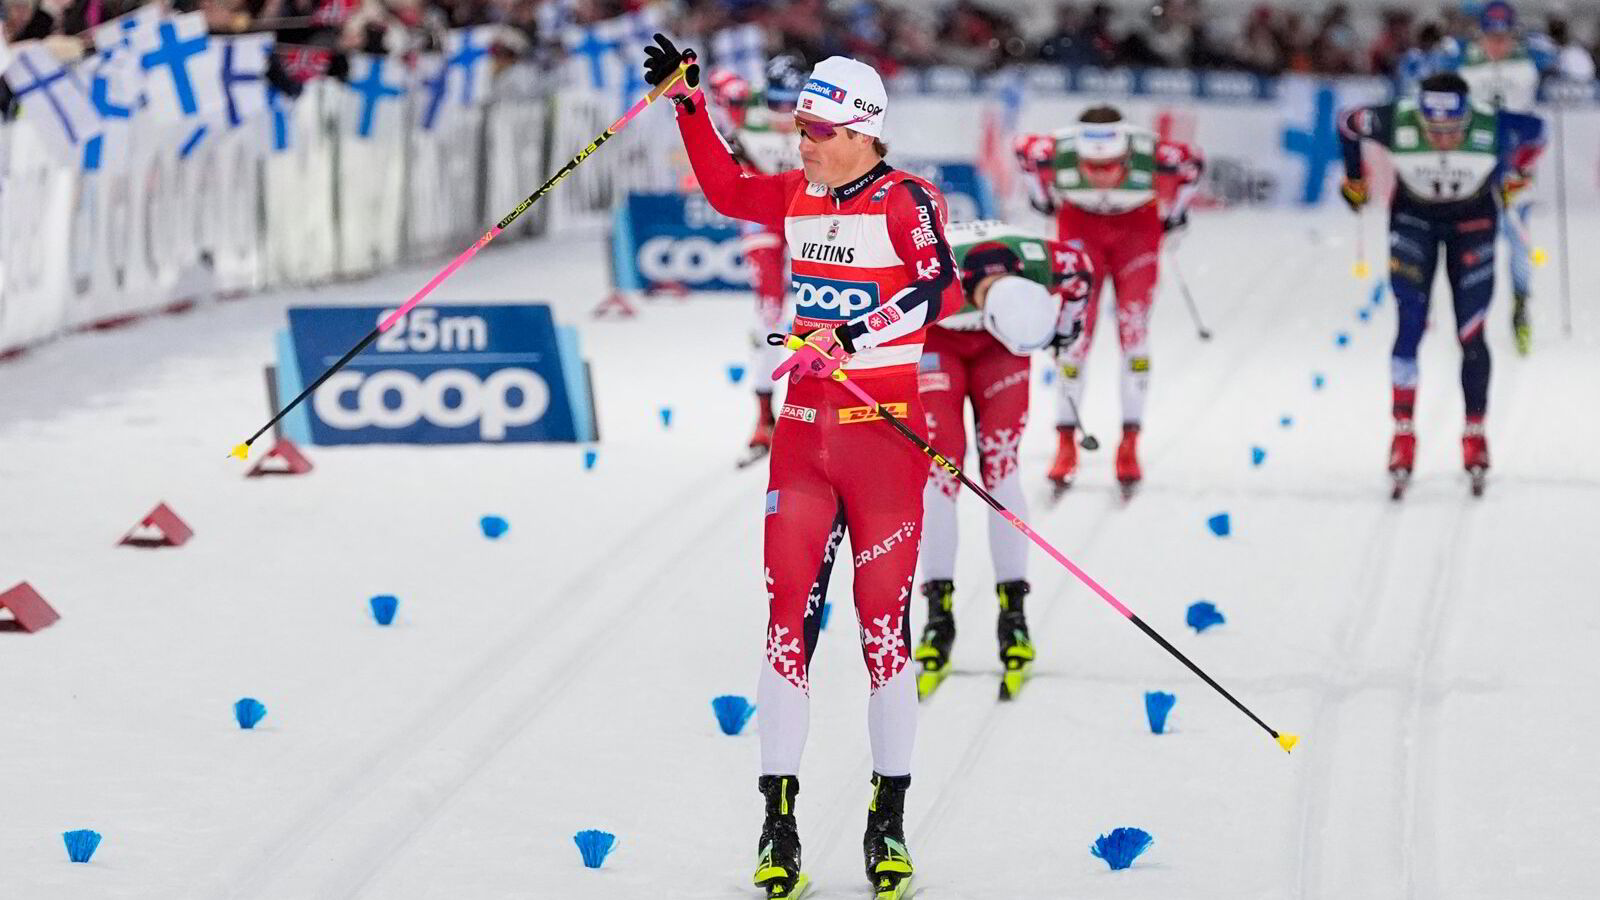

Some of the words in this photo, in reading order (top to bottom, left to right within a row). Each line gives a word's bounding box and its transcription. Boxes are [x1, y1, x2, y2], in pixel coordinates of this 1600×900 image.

[843, 177, 871, 196] CRAFT
[910, 227, 930, 250] ADE
[915, 205, 939, 246] POWER
[639, 235, 761, 282] coo
[800, 242, 855, 264] VELTINS
[375, 308, 488, 352] 25m
[803, 320, 833, 330] COUNTRY
[313, 367, 549, 441] coop
[923, 446, 959, 477] LEKI
[855, 528, 904, 568] CRAFT
